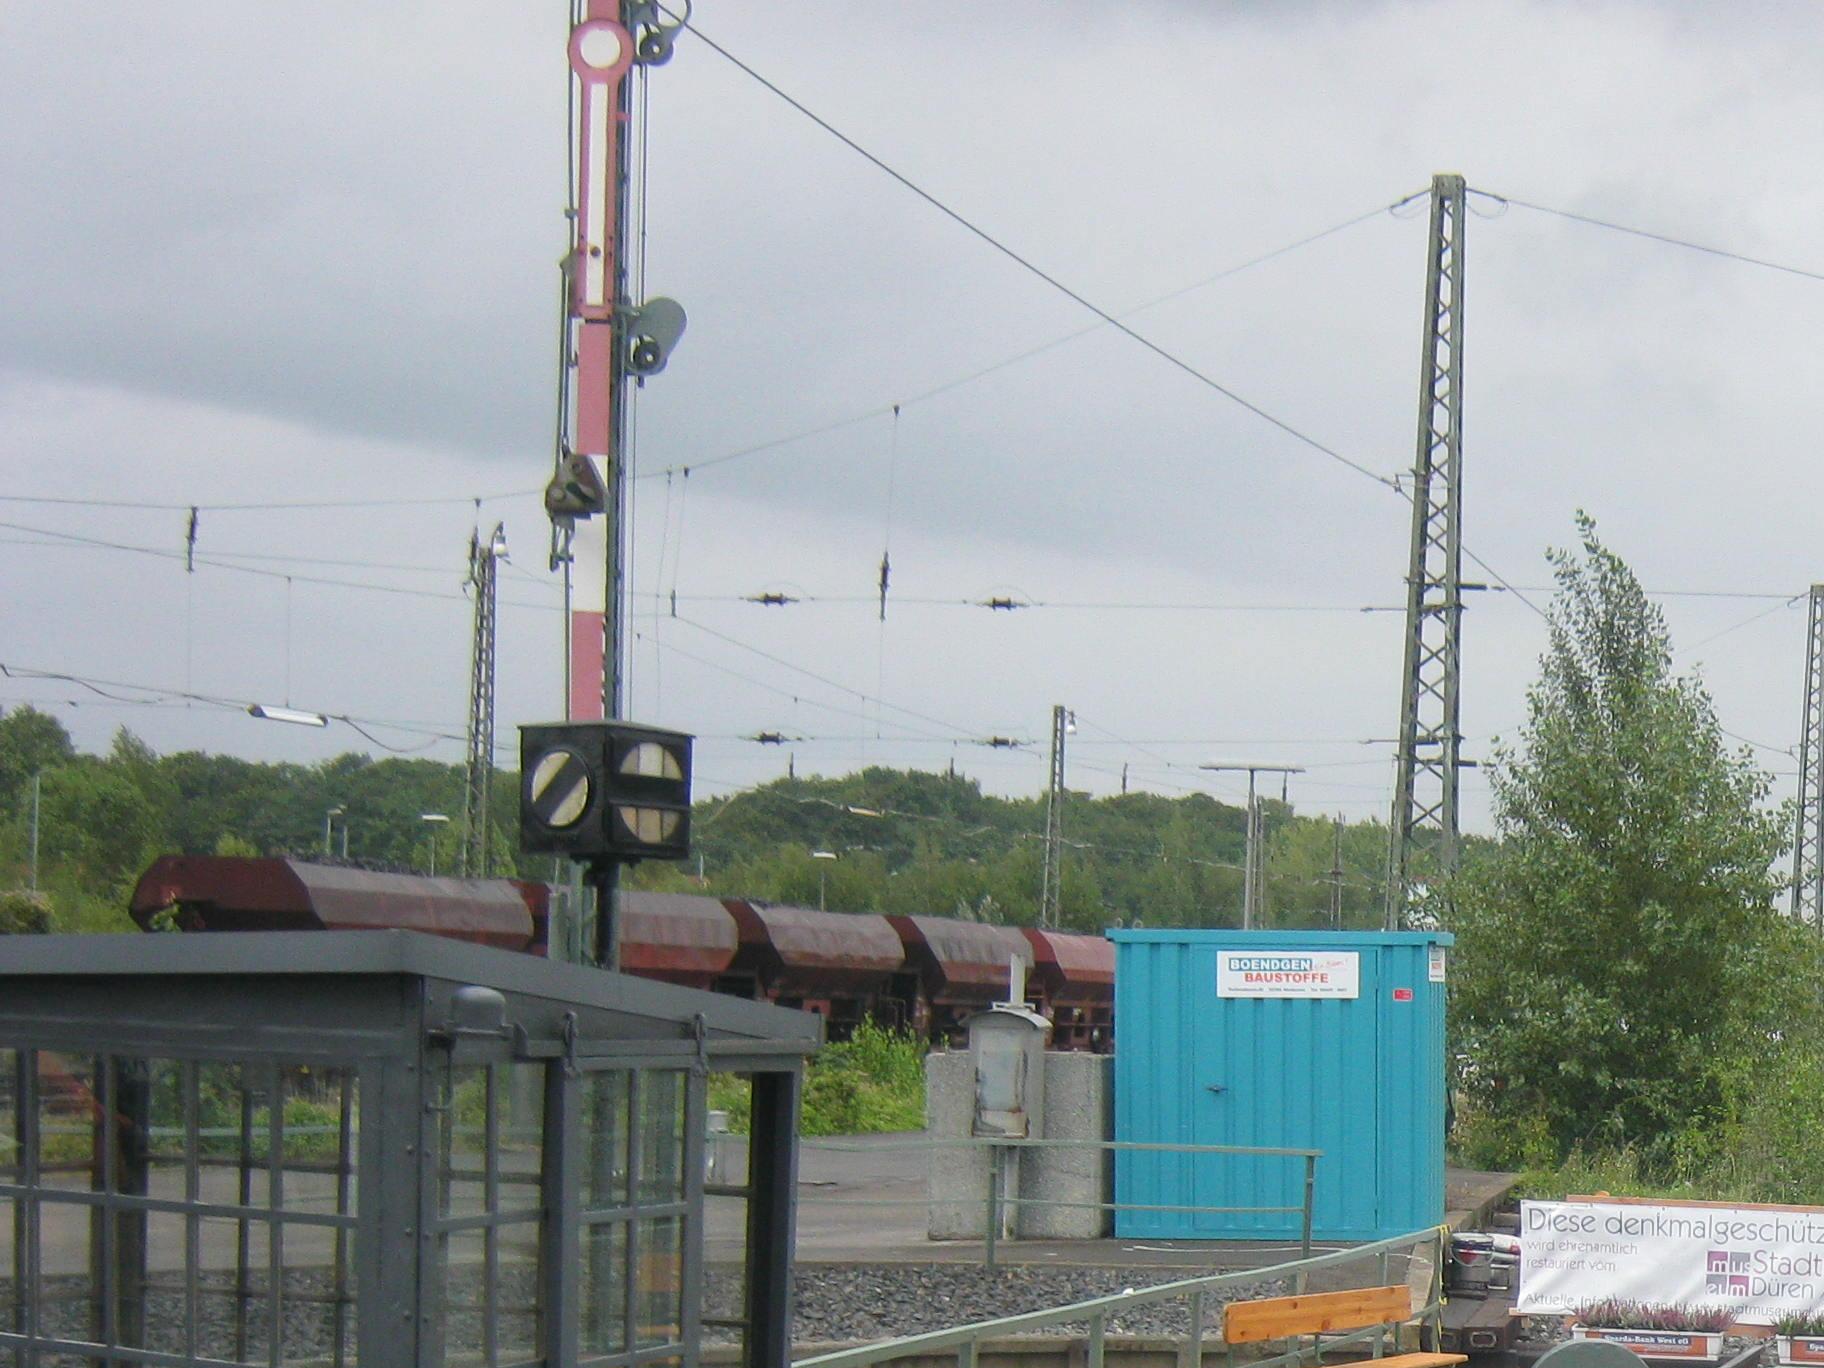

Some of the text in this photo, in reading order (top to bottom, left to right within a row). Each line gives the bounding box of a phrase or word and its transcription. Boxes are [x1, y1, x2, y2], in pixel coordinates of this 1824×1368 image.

[1230, 959, 1312, 970] BOENDGEN
[1244, 972, 1329, 983] BAUSTOFFE
[1528, 1207, 1597, 1233] Diese
[1527, 1239, 1638, 1255] wird ehrenamtlich
[1526, 1257, 1616, 1272] restauriert vom
[1752, 1275, 1814, 1299] Düren
[1525, 1293, 1575, 1307] Aktuelle
[1604, 1334, 1655, 1345] Sparda-Bank
[1658, 1336, 1677, 1345] West
